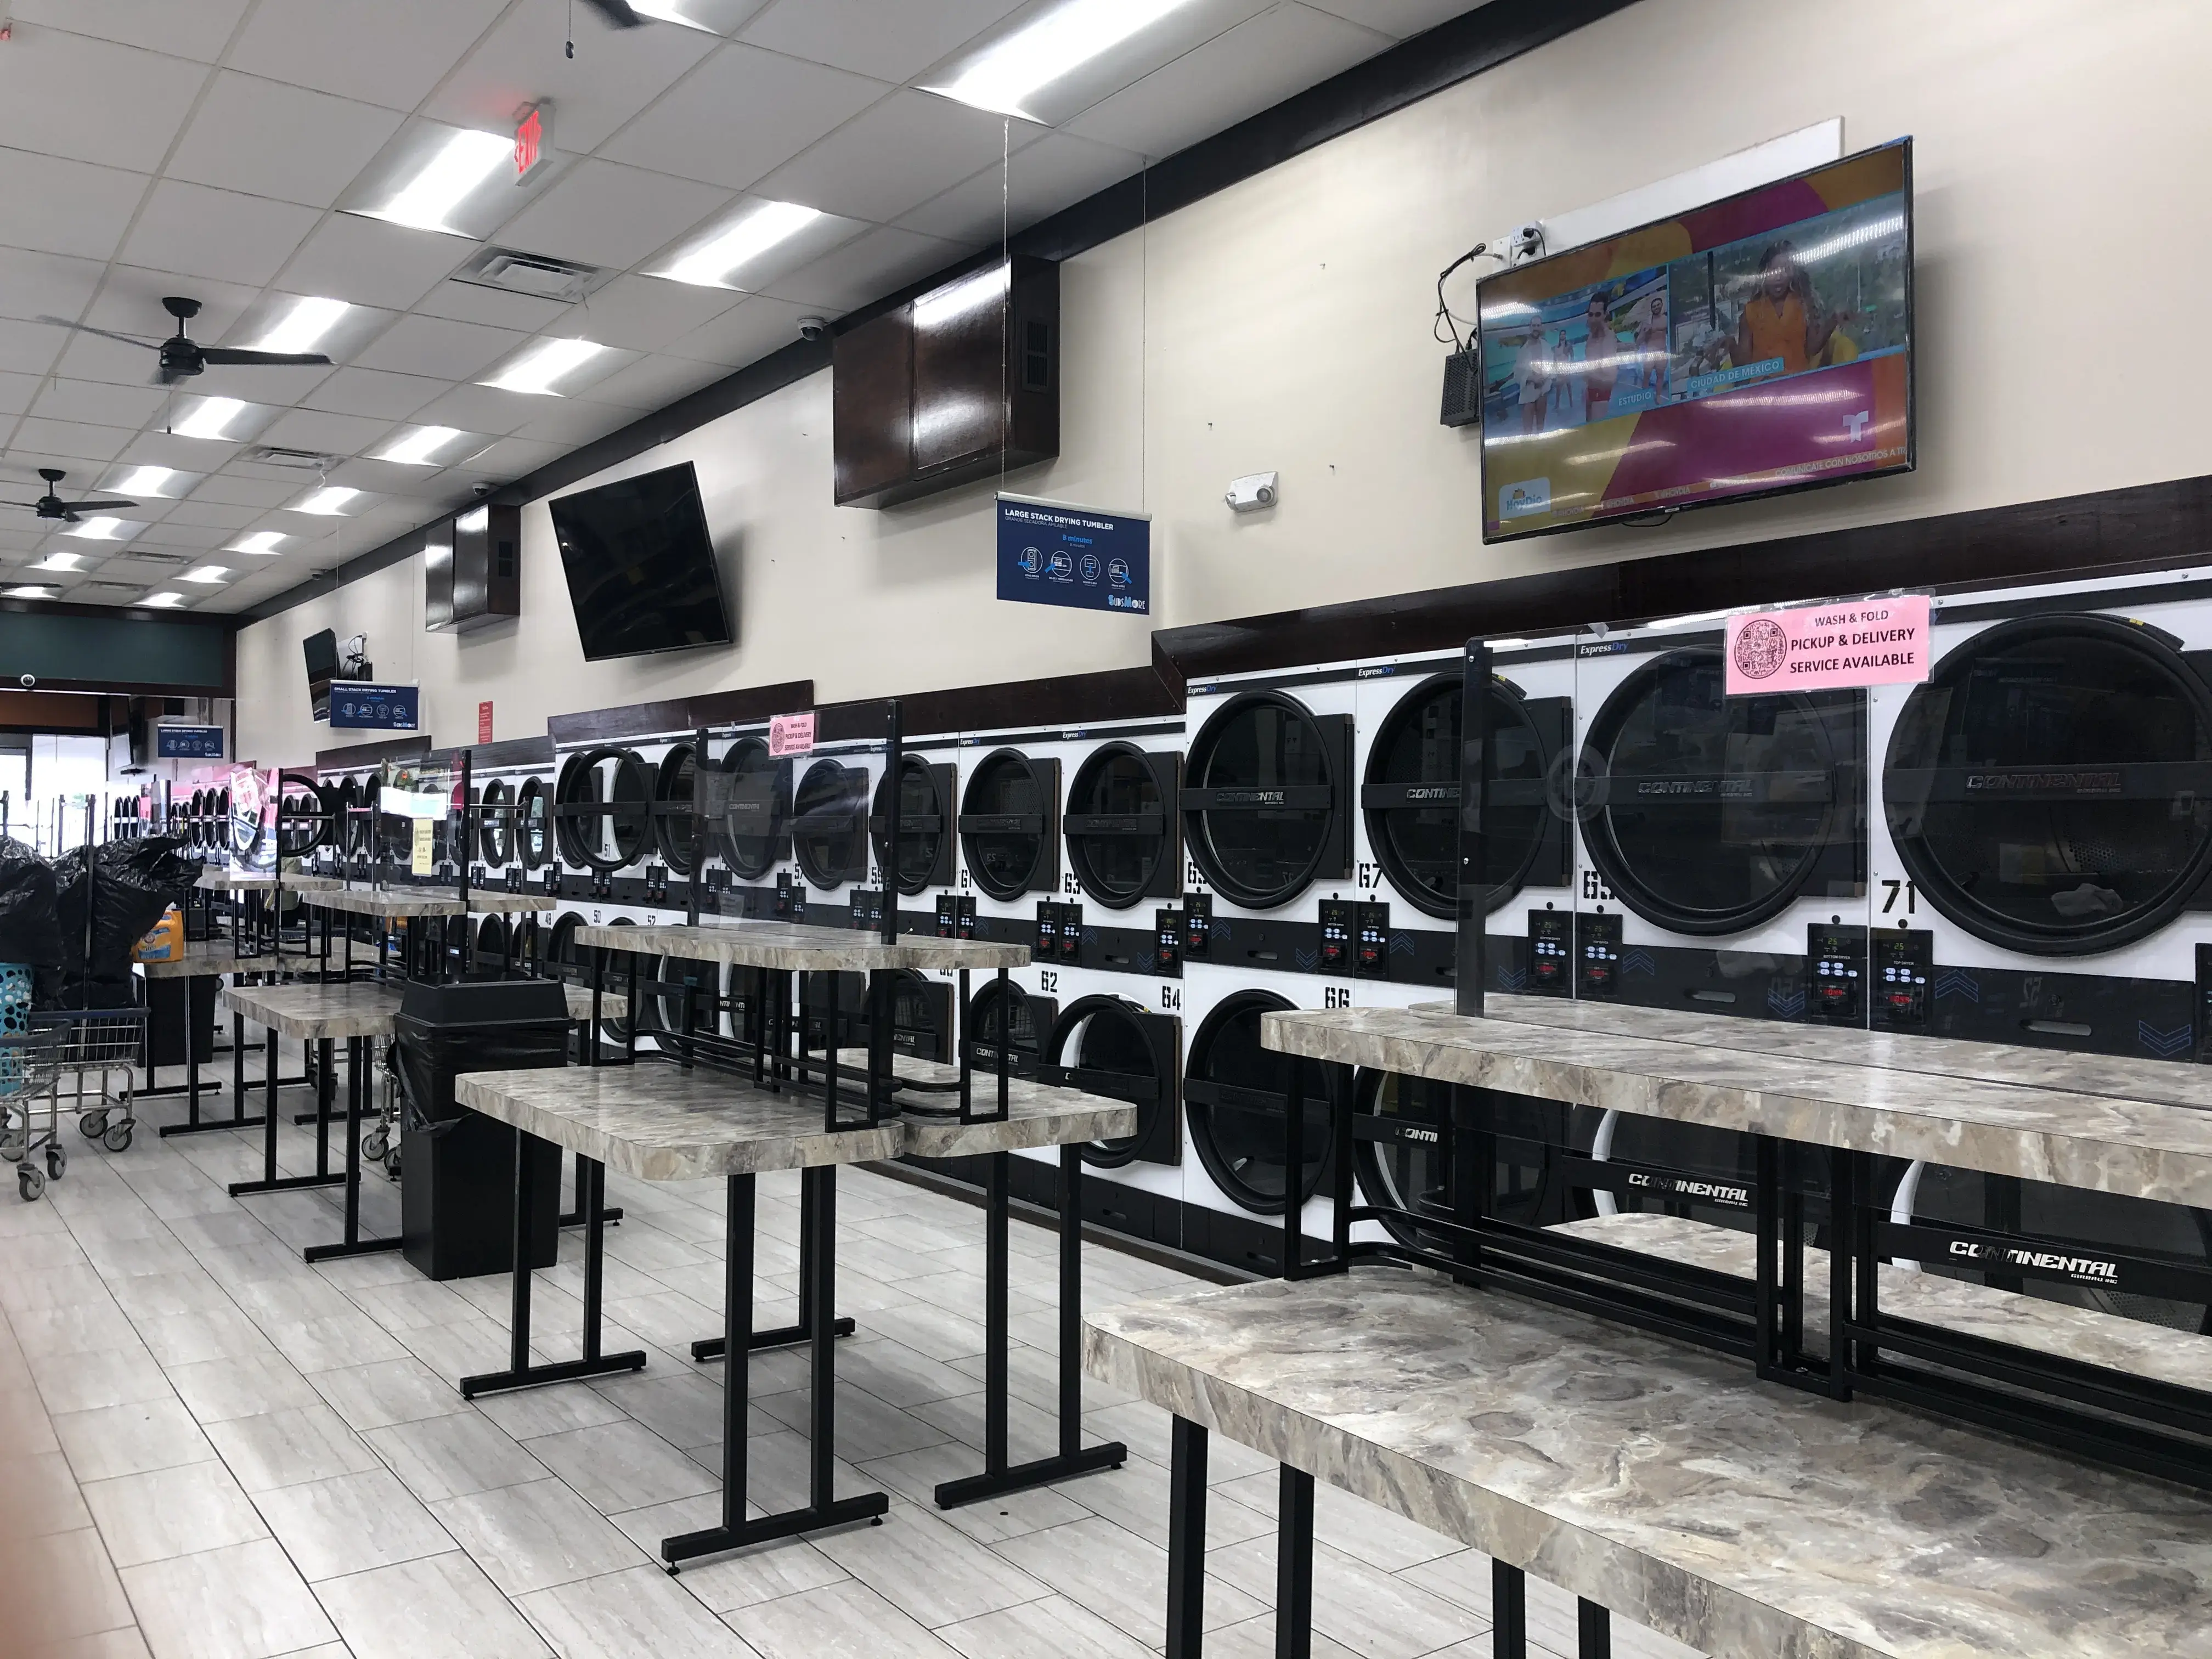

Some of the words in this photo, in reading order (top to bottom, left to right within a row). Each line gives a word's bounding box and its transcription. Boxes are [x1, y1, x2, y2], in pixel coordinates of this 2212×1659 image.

[1691, 374, 1725, 389] CIUDAD
[1728, 370, 1740, 380] DE
[1618, 392, 1651, 407] ESTUDIO
[1846, 450, 1888, 465] NOSOTROS
[1005, 509, 1029, 518] LARGE
[1030, 513, 1053, 522] STACK
[1054, 516, 1081, 526] DRYING
[1082, 520, 1114, 531] TUMBLER
[1068, 535, 1093, 544] minutes
[1815, 615, 1846, 627] WASH
[1849, 613, 1857, 623] &
[1861, 610, 1888, 623] FOLD
[1791, 635, 1835, 651] PICKUP
[1838, 635, 1848, 646] &
[1853, 628, 1915, 645] DELIVERY
[1581, 642, 1628, 656] ExpressDry
[1790, 658, 1839, 673] SERVICE
[1843, 652, 1915, 669] AVAILABLE
[1358, 665, 1395, 676] ExpressDry
[1188, 685, 1217, 695] ExpressDry
[1063, 731, 1087, 740] ExpressDry
[1639, 780, 1752, 793] CONTINENTAL
[1966, 773, 2121, 788] CONTINENTAL
[1217, 792, 1284, 802] CONTINENTAL
[605, 844, 610, 857] 51
[961, 870, 971, 888] 61
[1359, 863, 1383, 888] 67
[1882, 879, 1916, 914] 71
[545, 912, 551, 925] 48
[594, 910, 601, 923] 50
[647, 915, 656, 926] 52
[1041, 970, 1057, 992] 62
[1162, 985, 1181, 1011] 64
[1325, 986, 1350, 1008] 66
[1628, 1173, 1748, 1201] CONTINENTAL
[1949, 1241, 2118, 1278] CONTINENTAL
